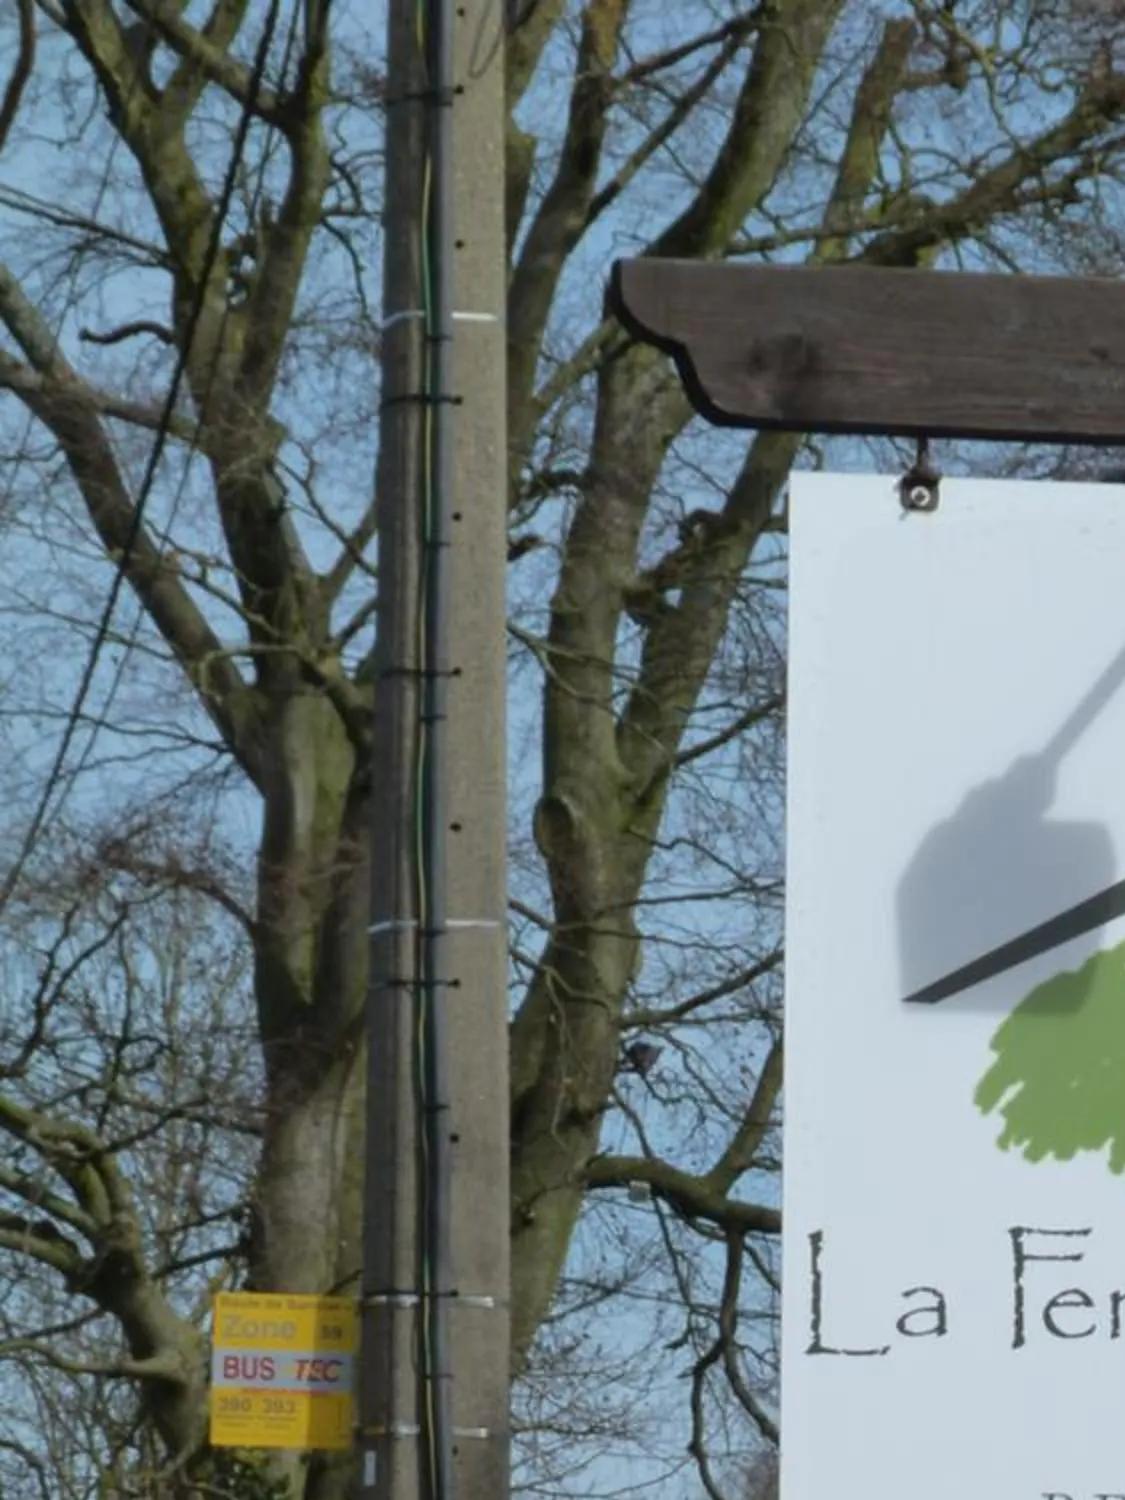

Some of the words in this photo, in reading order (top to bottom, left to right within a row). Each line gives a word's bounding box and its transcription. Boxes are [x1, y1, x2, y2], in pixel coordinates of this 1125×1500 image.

[804, 1229, 948, 1357] La
[221, 1314, 297, 1340] Zone
[223, 1355, 276, 1381] BUS
[294, 1358, 345, 1383] TEC
